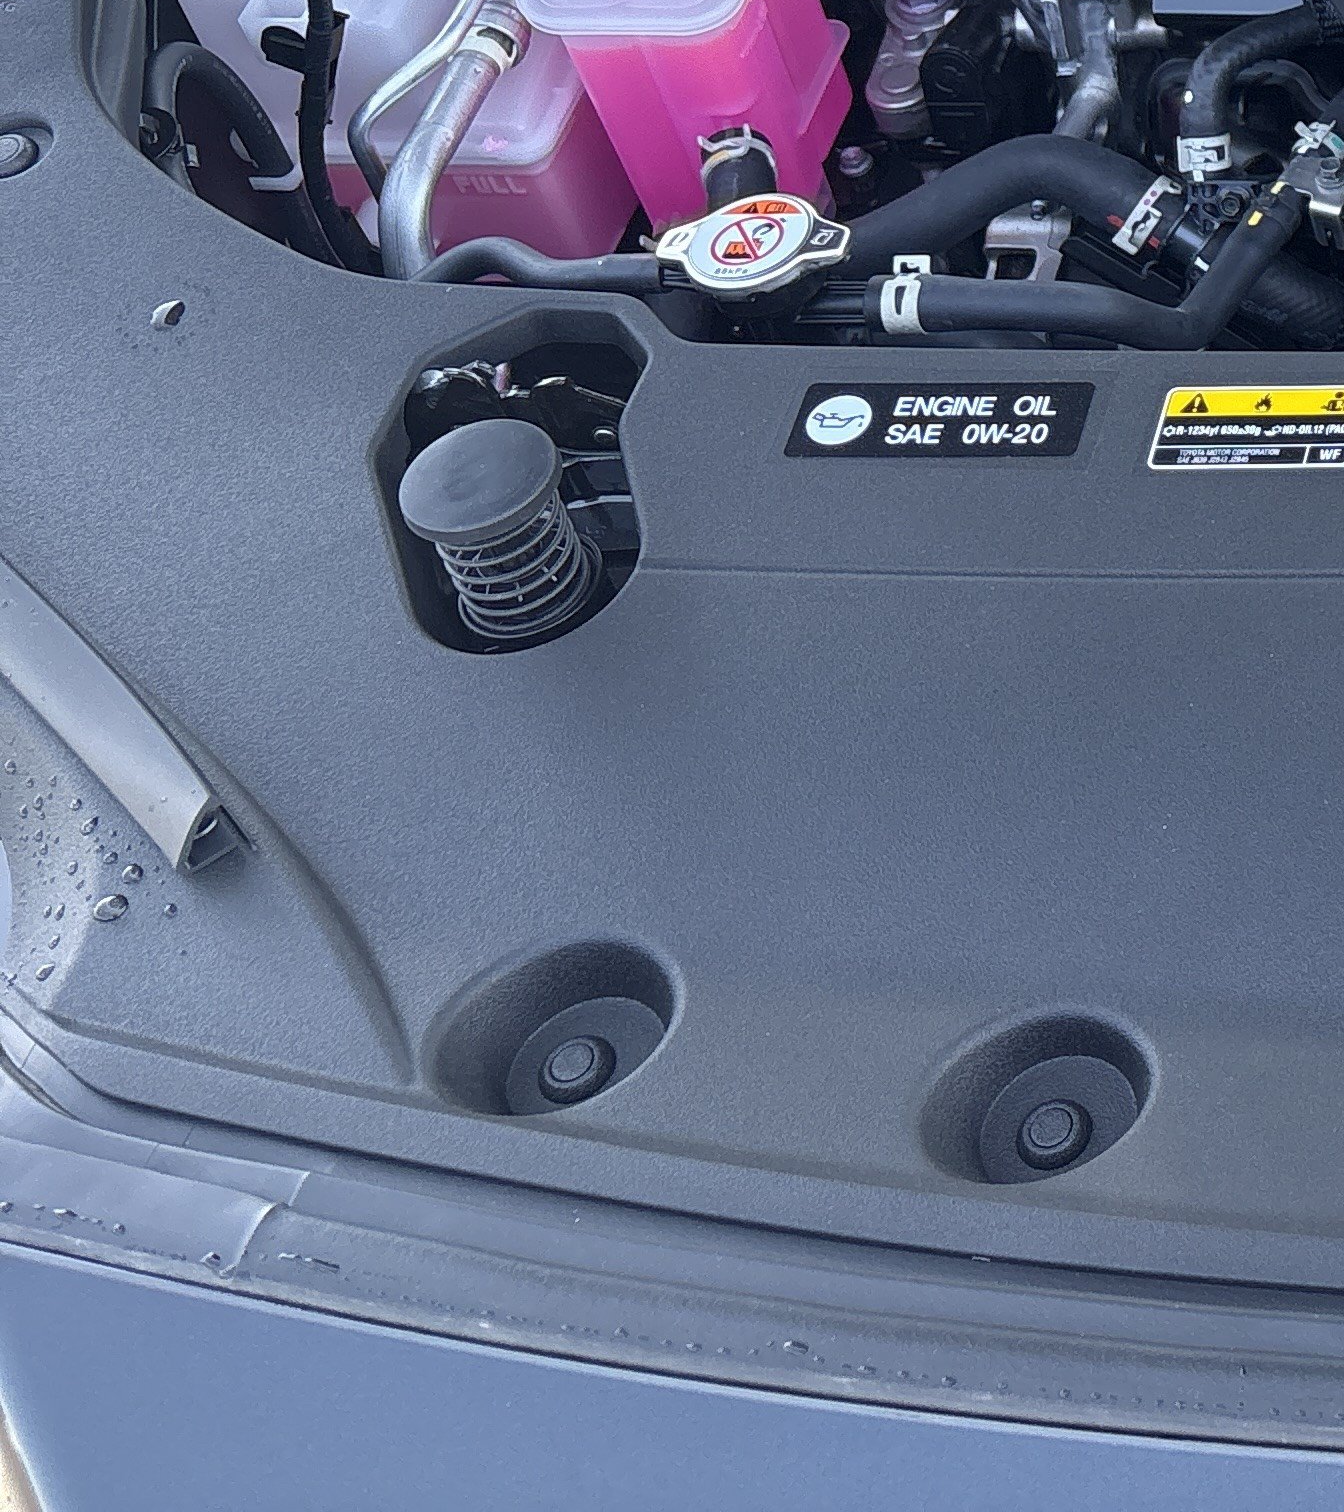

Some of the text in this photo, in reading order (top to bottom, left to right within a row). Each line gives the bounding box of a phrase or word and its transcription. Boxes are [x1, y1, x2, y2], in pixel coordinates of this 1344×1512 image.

[452, 175, 527, 194] FULL
[893, 395, 1058, 417] ENGINE OIL
[884, 423, 1049, 445] SAE 0W-20
[1232, 448, 1280, 456] CORPORATION
[1319, 448, 1342, 461] WF
